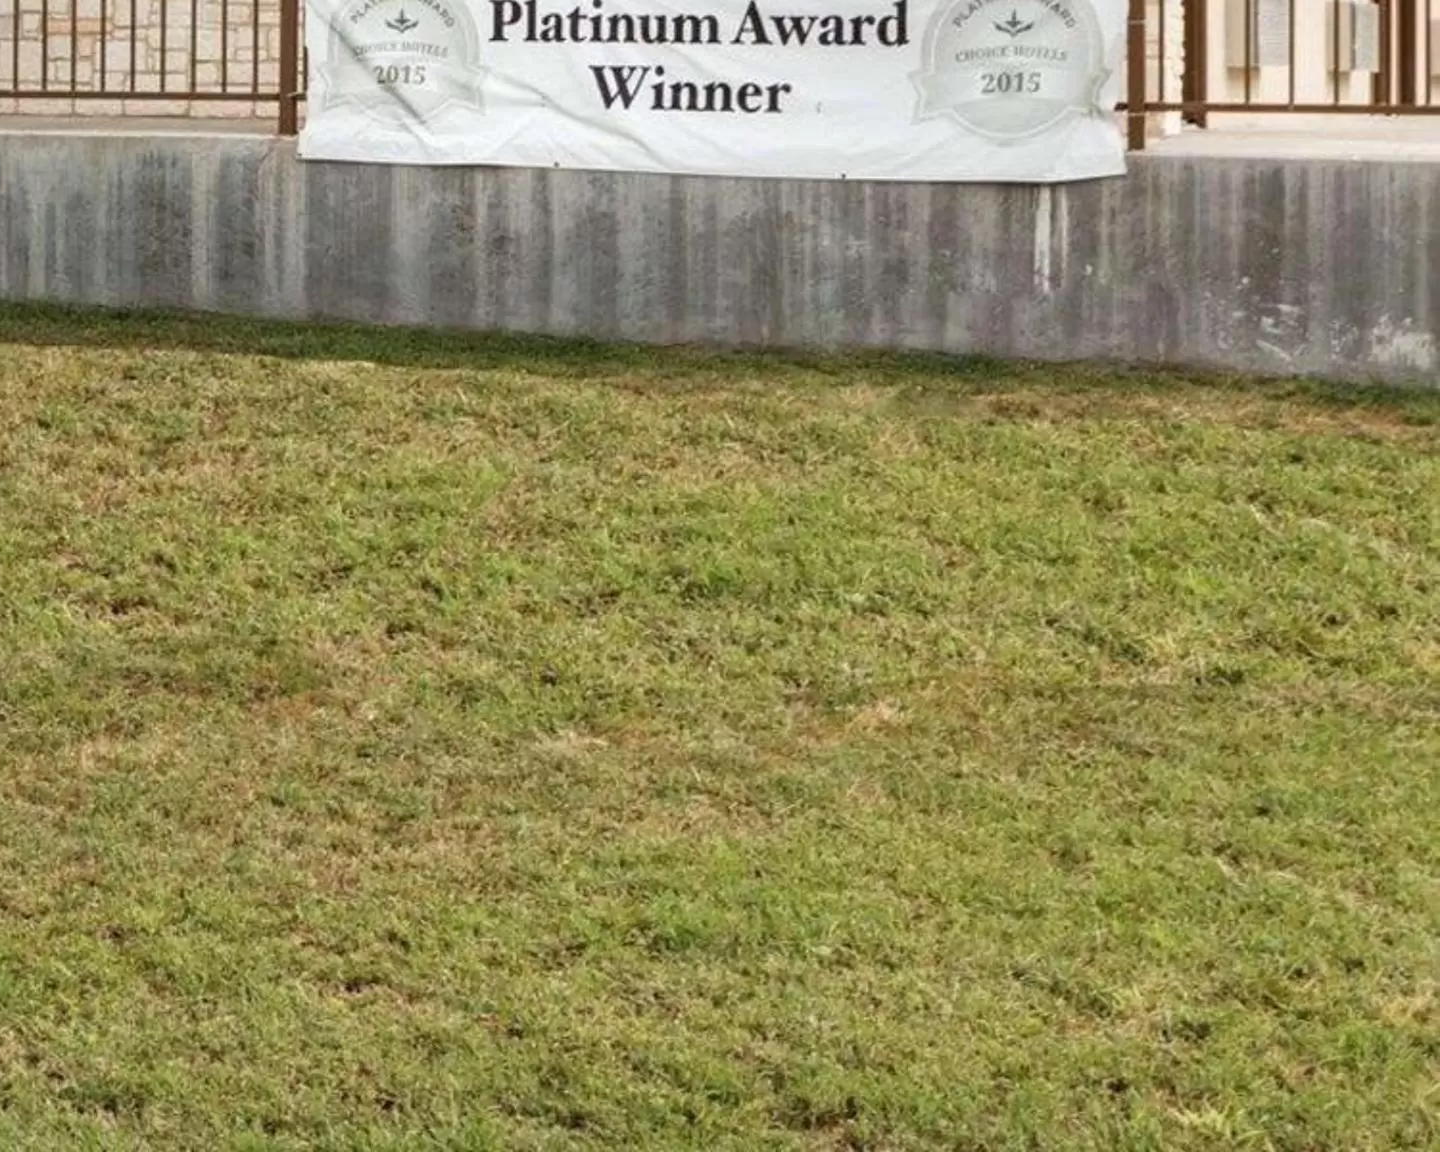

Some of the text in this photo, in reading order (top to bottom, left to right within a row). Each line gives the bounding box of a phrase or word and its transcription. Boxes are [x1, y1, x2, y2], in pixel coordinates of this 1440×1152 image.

[372, 64, 427, 86] 2015
[980, 71, 1042, 95] 2015
[588, 65, 793, 114] Winner
